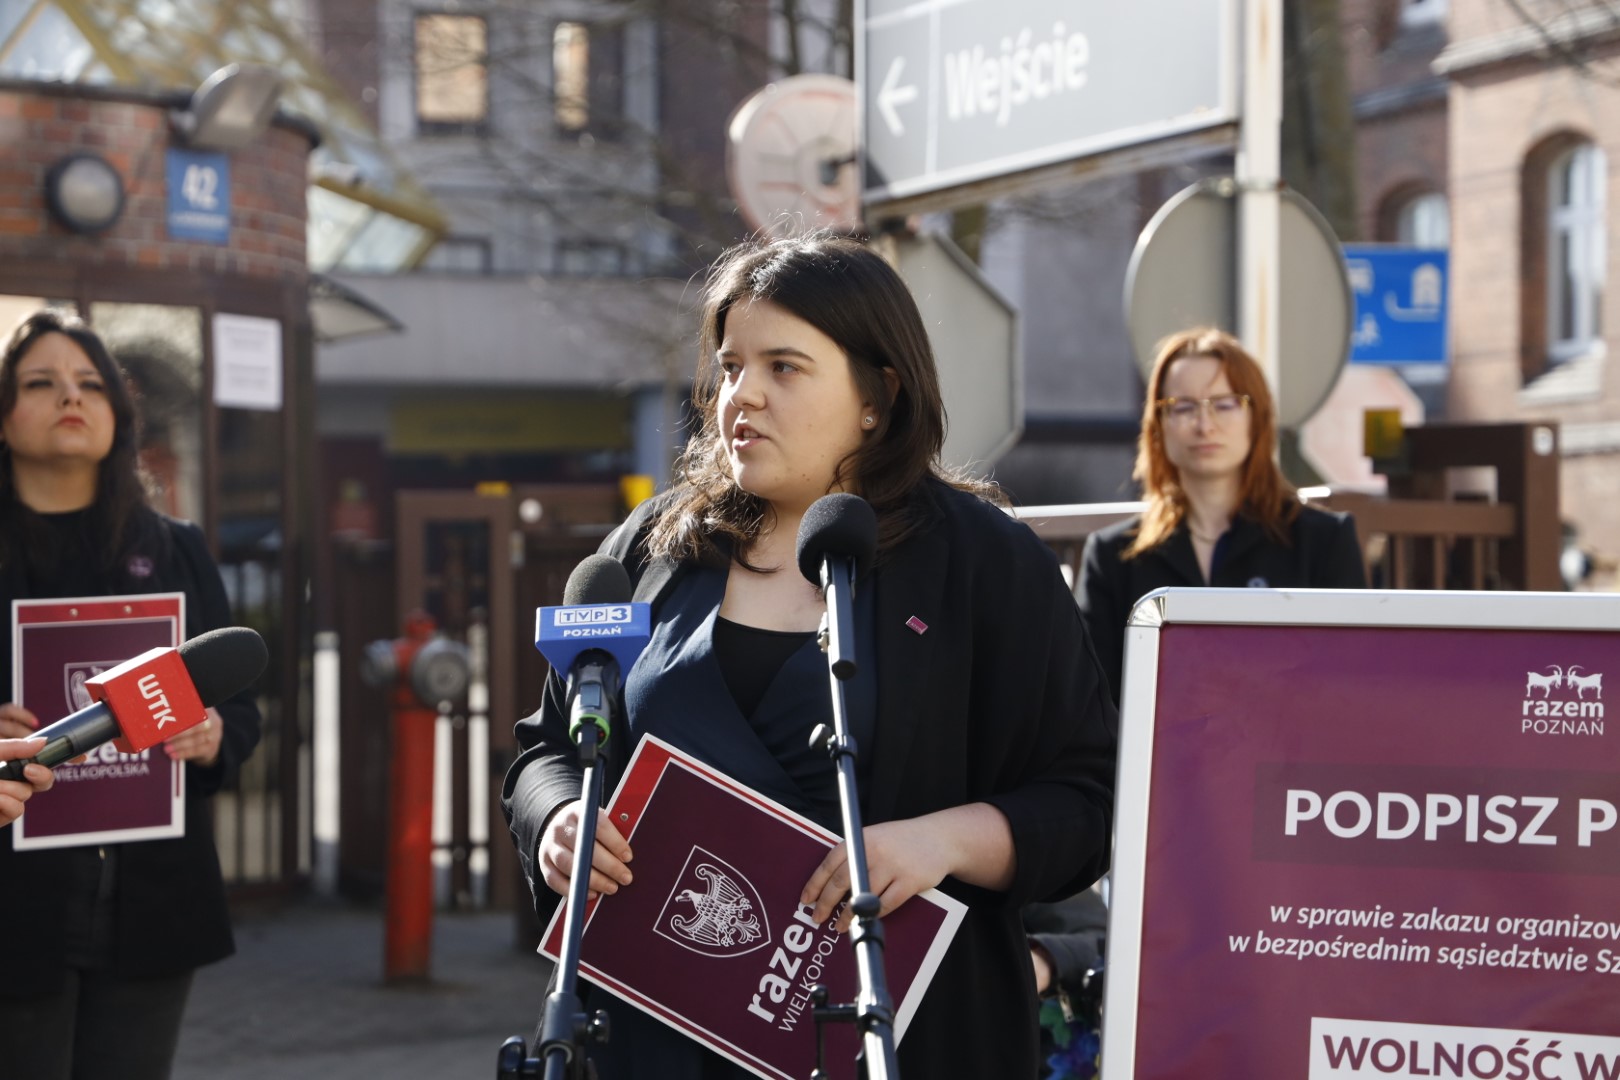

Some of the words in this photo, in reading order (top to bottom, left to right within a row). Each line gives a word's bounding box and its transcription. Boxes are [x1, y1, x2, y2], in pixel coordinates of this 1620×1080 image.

[945, 20, 1090, 127] Wejście
[181, 164, 219, 211] 42
[563, 625, 622, 638] POZNAŃ
[137, 673, 177, 731] WTK
[1522, 700, 1605, 718] razem
[1521, 718, 1605, 736] POZNAŃ
[1284, 789, 1560, 845] PODPISZ
[1270, 905, 1293, 923] w
[1297, 904, 1395, 929] sprawie
[1400, 907, 1490, 933] zakazu
[1228, 935, 1251, 953] w
[1255, 930, 1431, 963] bezpośrednim
[1437, 942, 1588, 972] sąsiedztwie
[1322, 1034, 1563, 1080] WOLNOŚĆ
